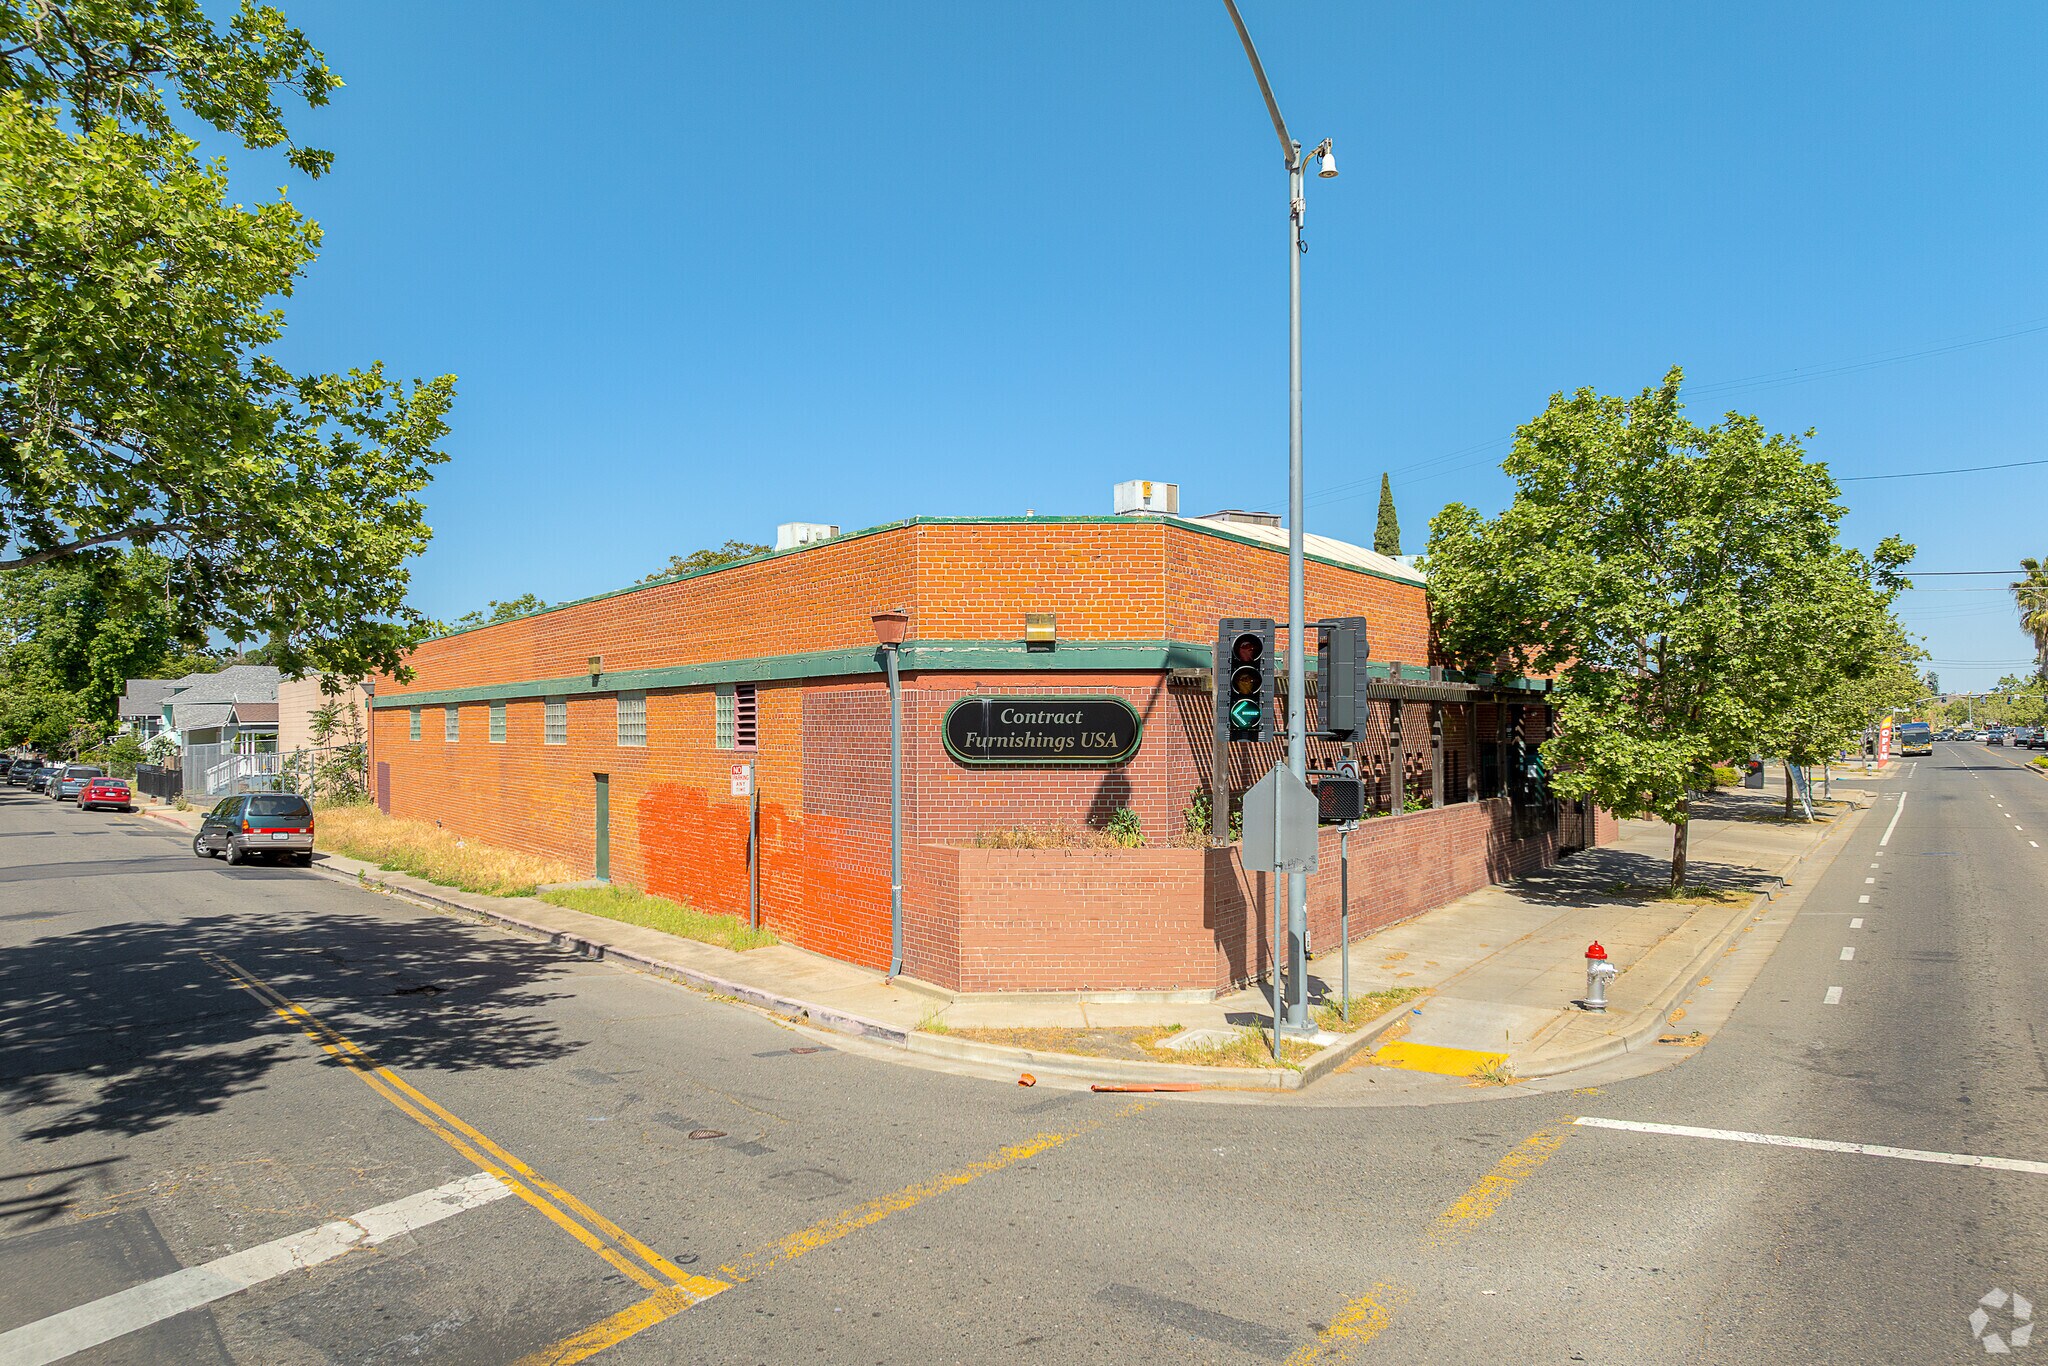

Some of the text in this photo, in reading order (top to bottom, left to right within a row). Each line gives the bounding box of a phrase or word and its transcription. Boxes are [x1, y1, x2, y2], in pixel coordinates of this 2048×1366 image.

[1000, 708, 1083, 725] Contract
[964, 732, 1118, 753] Furnishings USA
[1880, 729, 1890, 760] OPEN
[733, 766, 742, 774] NO
